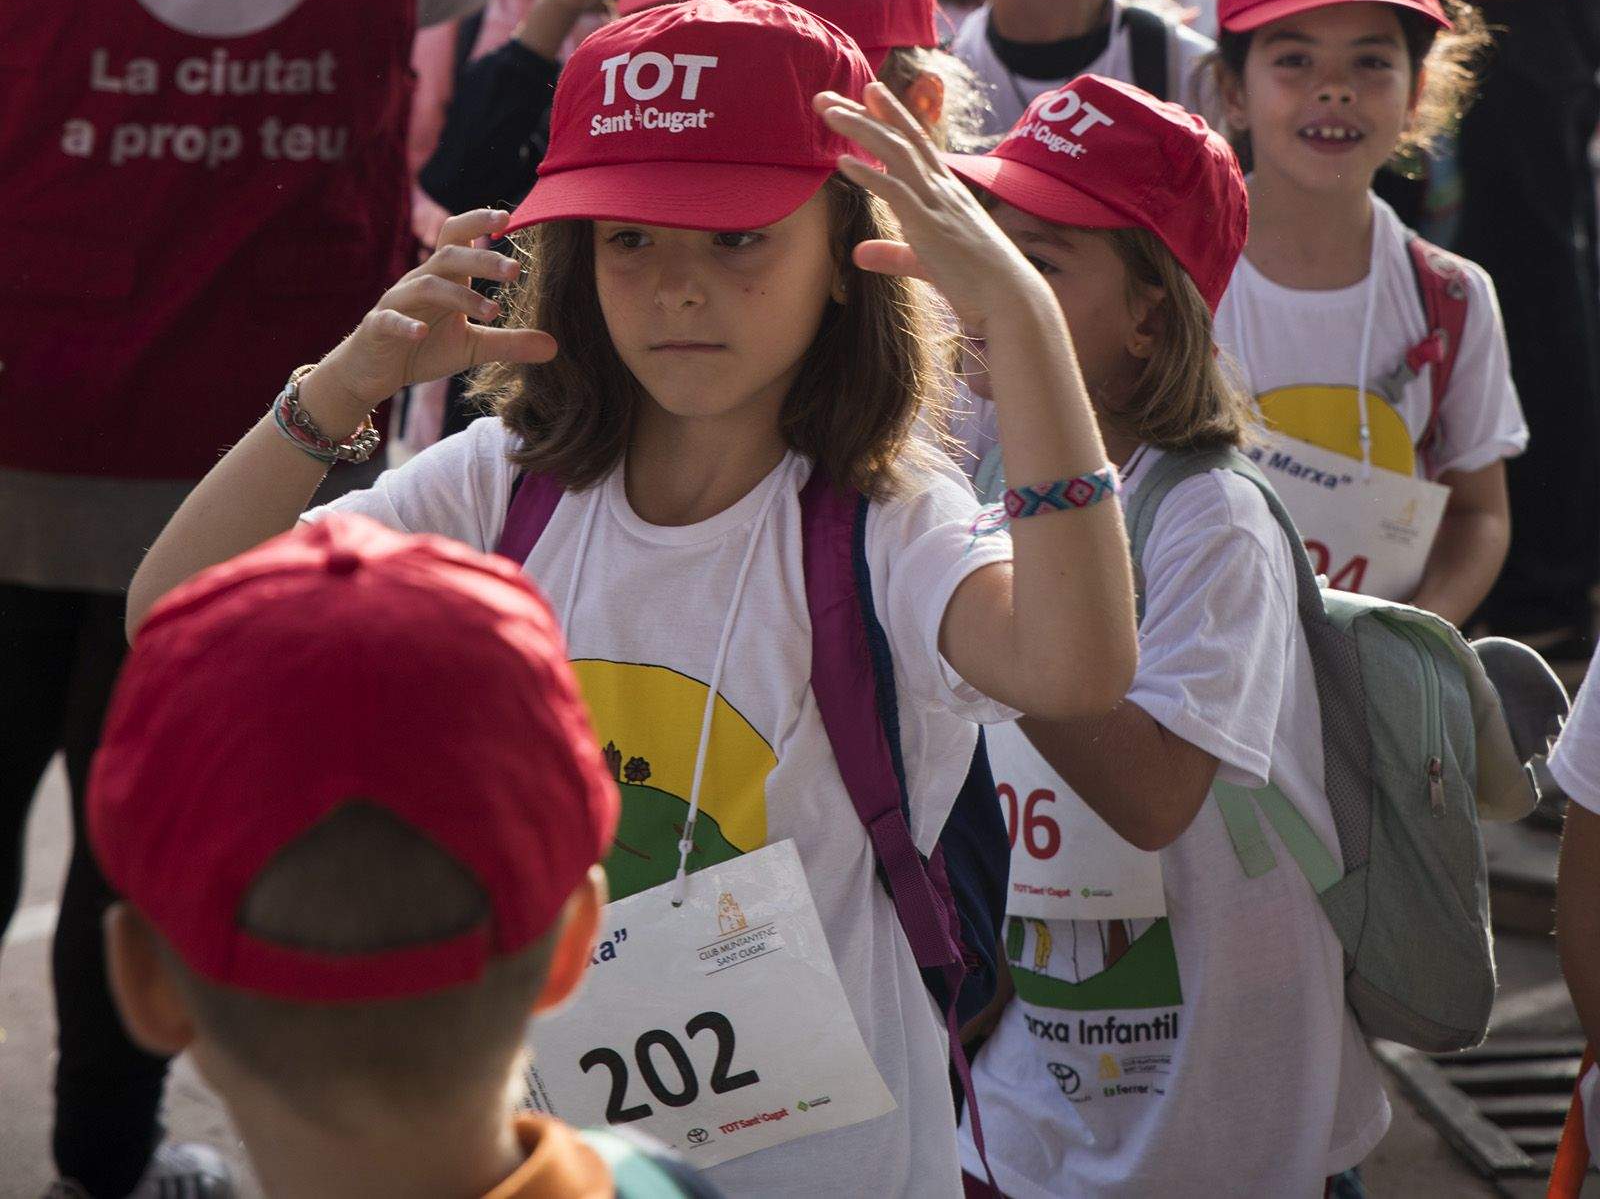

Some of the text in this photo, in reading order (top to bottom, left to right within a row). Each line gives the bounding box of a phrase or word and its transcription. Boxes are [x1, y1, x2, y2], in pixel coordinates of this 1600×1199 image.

[90, 49, 336, 95] La ciutat
[600, 52, 719, 106] TOT
[590, 109, 633, 136] Sant
[1038, 89, 1115, 137] OT
[61, 116, 346, 168] a prop teu
[1034, 124, 1083, 158] Cugat
[717, 942, 765, 967] SANT CUGAT
[1079, 1012, 1179, 1045] Infantil
[579, 1011, 760, 1124] 202
[719, 1121, 741, 1134] TOT
